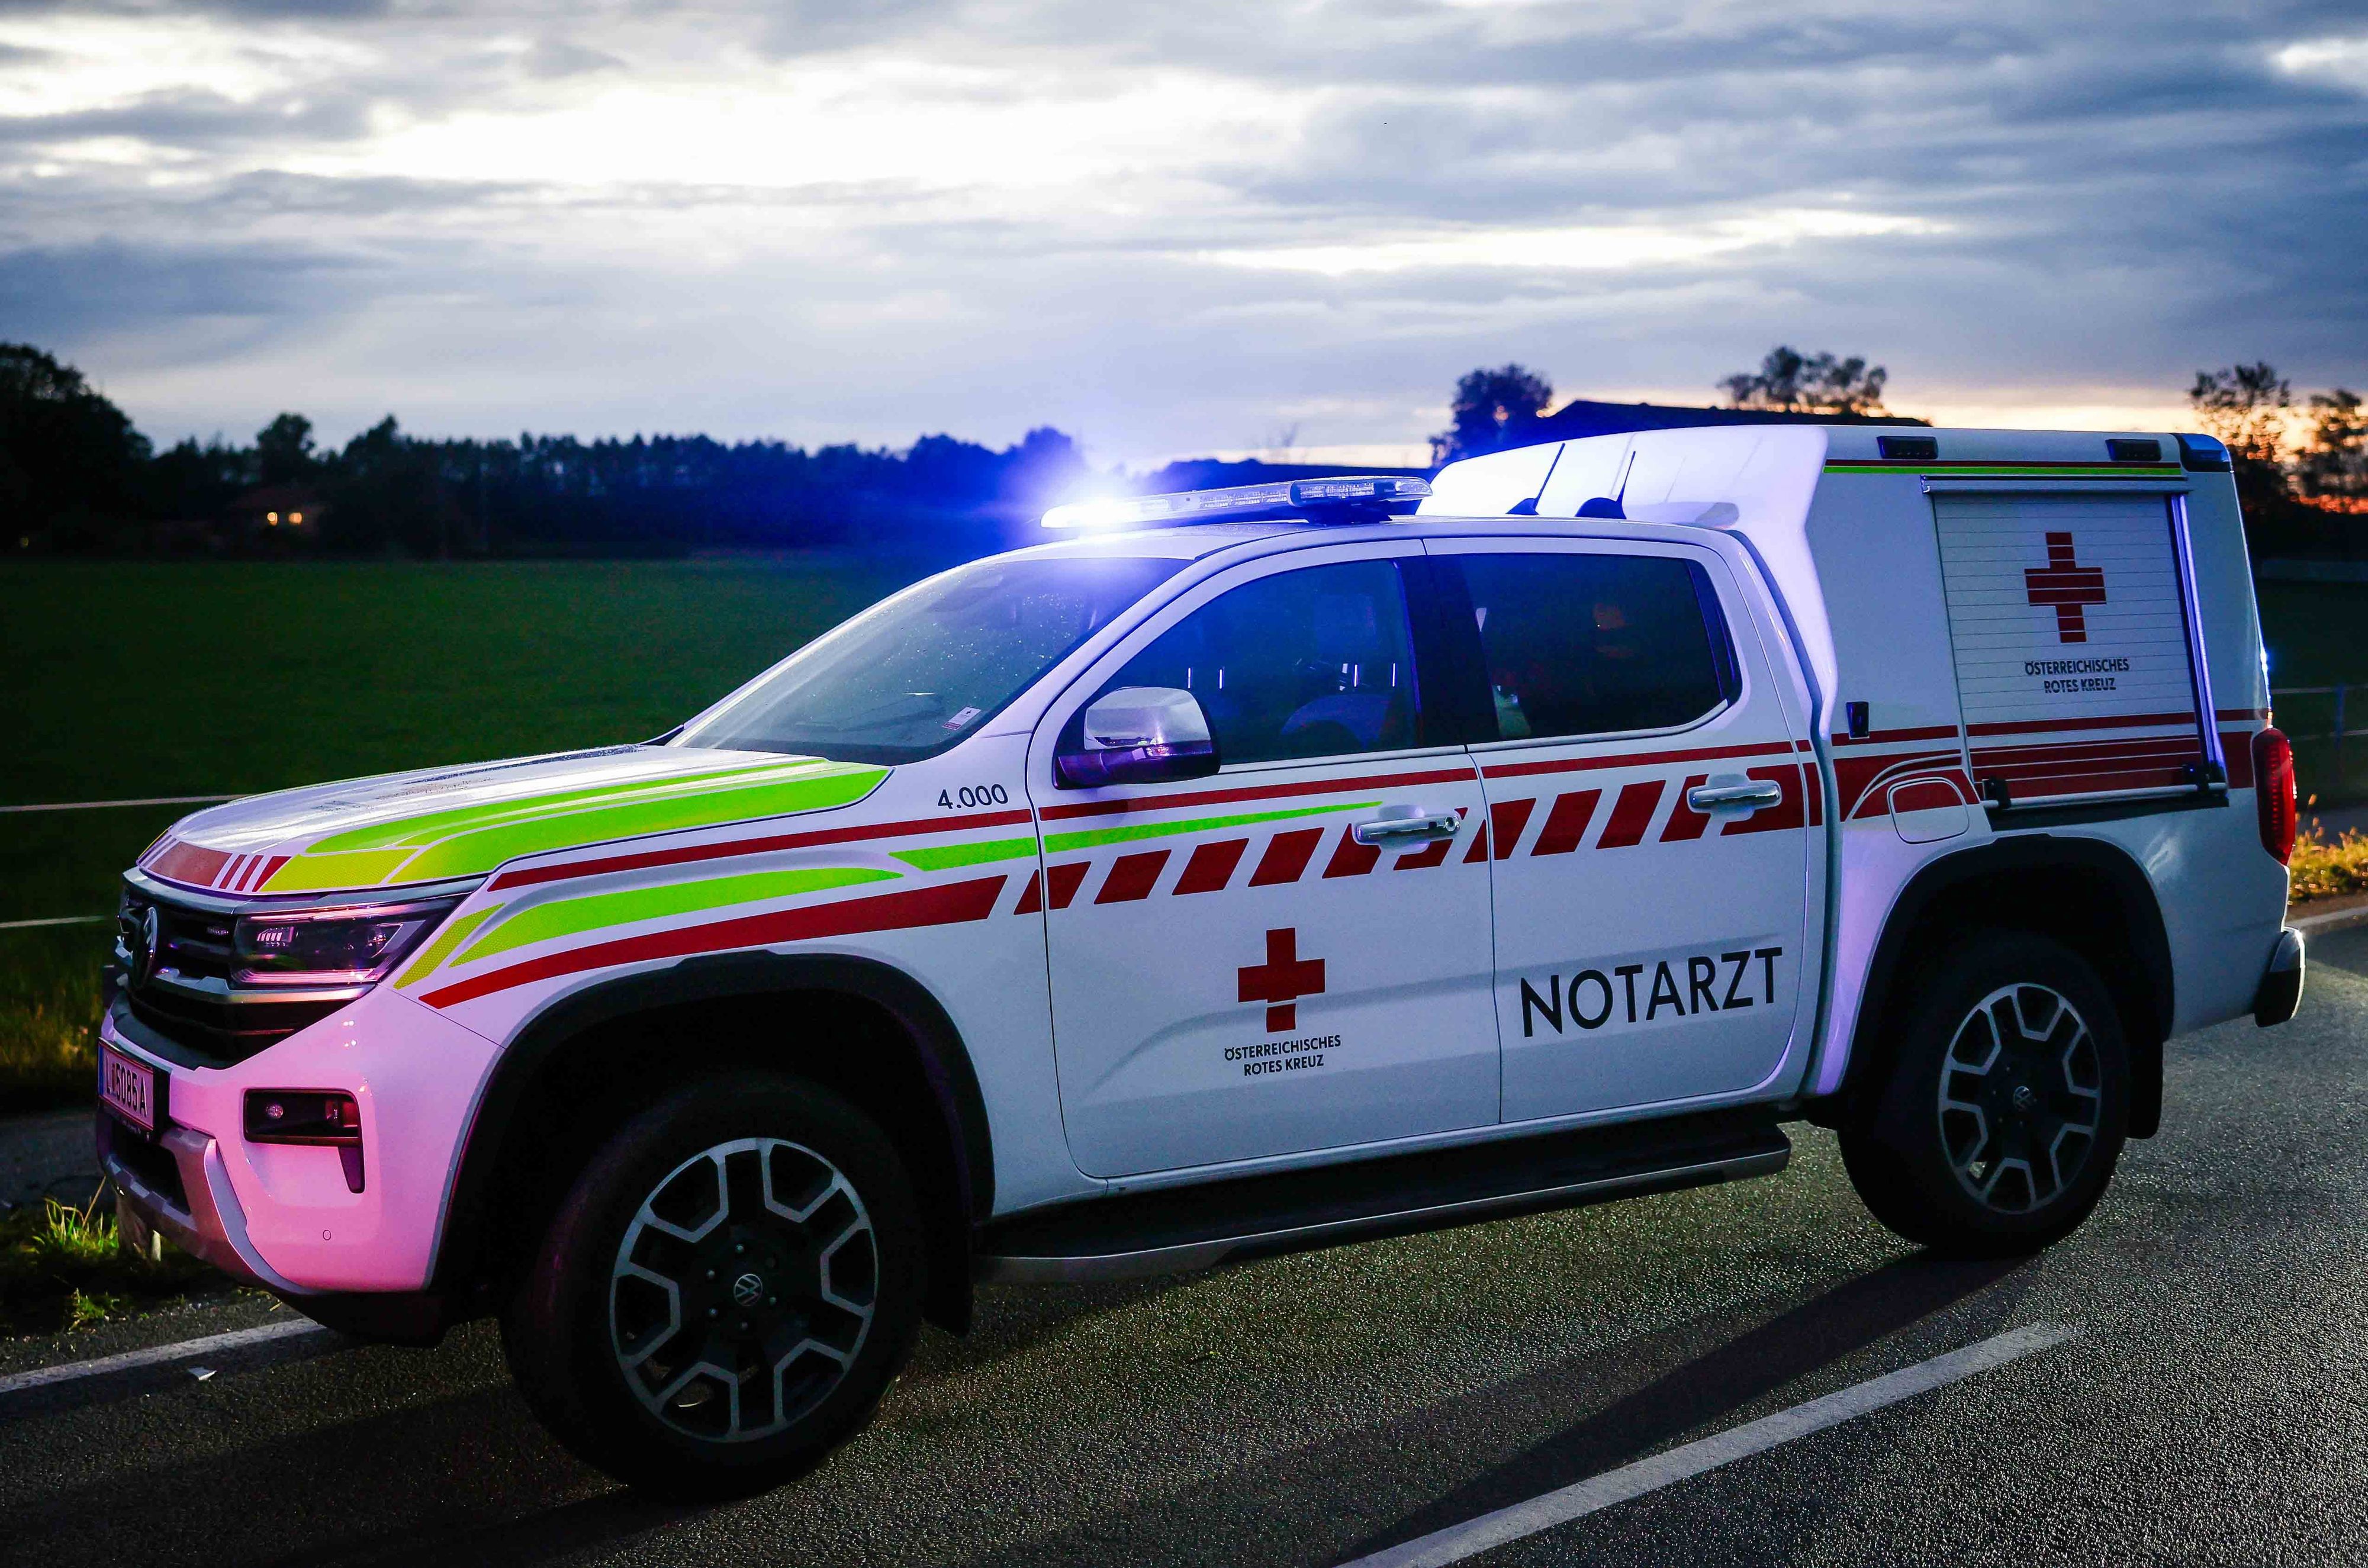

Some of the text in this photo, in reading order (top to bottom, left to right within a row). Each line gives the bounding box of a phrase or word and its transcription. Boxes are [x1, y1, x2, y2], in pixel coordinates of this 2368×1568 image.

[2025, 658, 2130, 676] ÖSTERREICHISCHES
[2044, 677, 2117, 694] ROTES KREUZ
[937, 784, 1009, 809] 4.000
[1520, 946, 1783, 1038] NOTARZT
[1224, 1034, 1341, 1061] ÖSTERREICHISCHES
[1243, 1054, 1324, 1077] ROTES KREUZ
